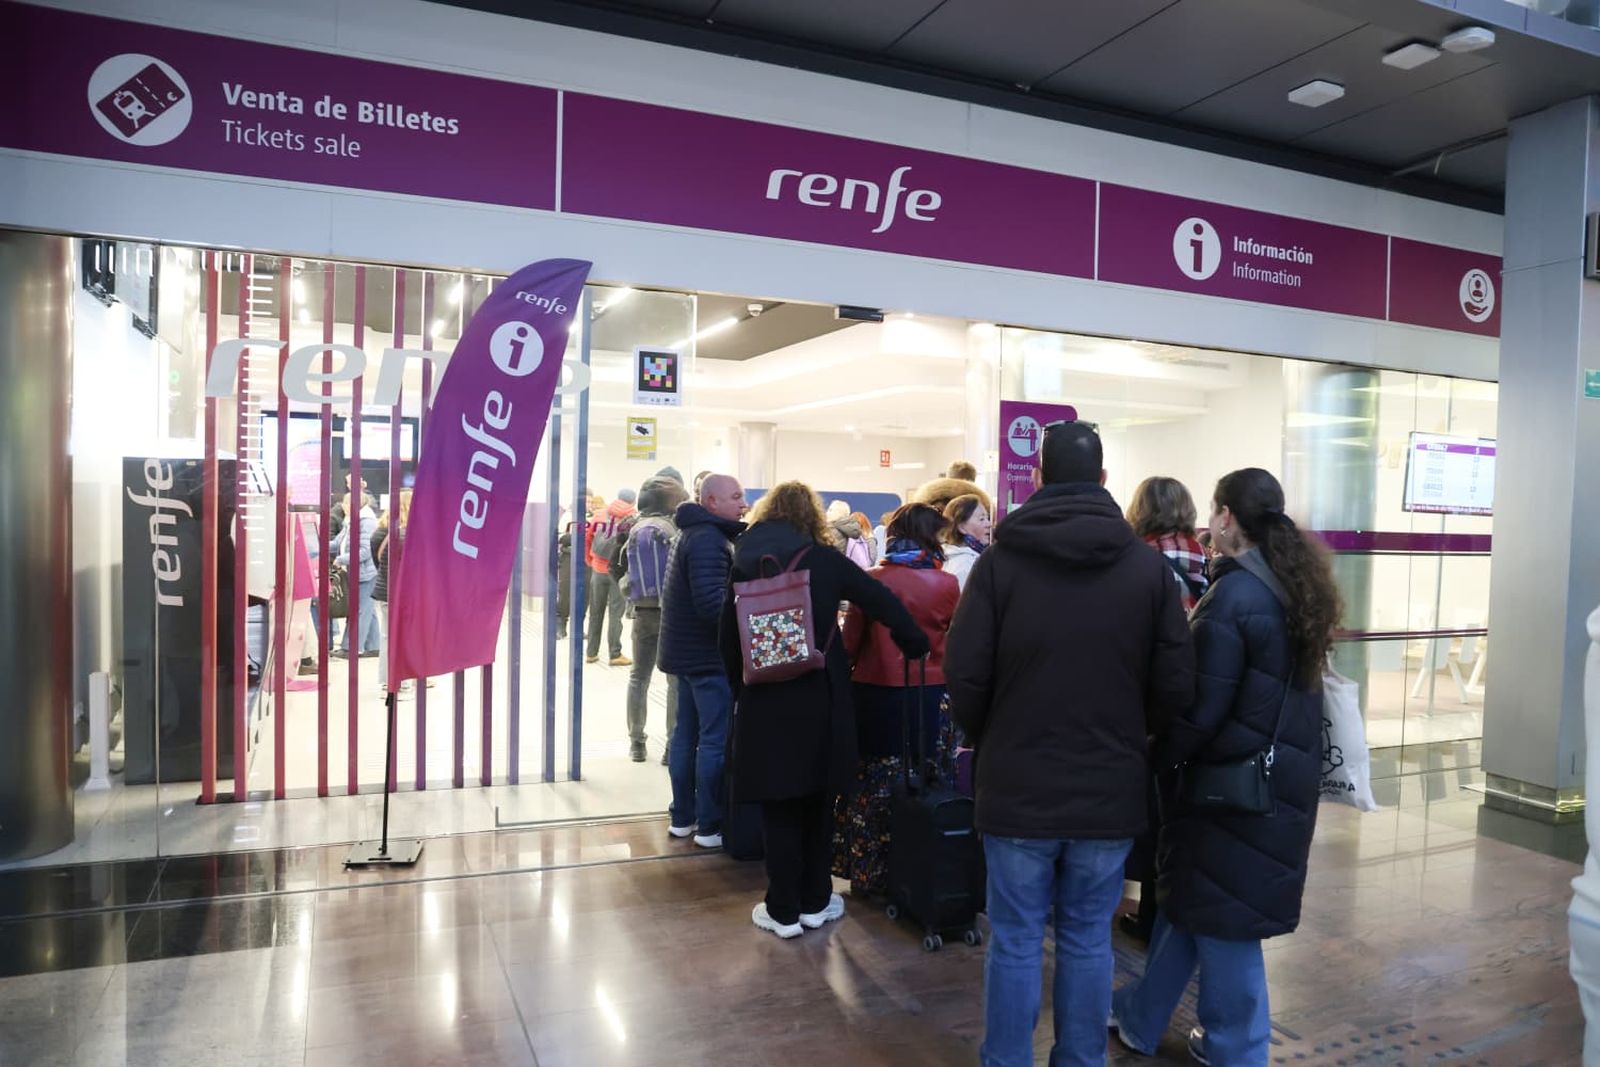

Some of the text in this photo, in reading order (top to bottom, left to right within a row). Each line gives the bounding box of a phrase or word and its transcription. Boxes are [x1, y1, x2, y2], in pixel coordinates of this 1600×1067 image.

[222, 82, 459, 135] Venta de Billetes
[221, 119, 361, 158] Tickets sale
[765, 166, 942, 233] renfe
[1233, 235, 1314, 265] Información
[1232, 260, 1302, 287] Information
[515, 289, 568, 316] renfe
[452, 389, 517, 560] renfe
[127, 457, 194, 607] renfe
